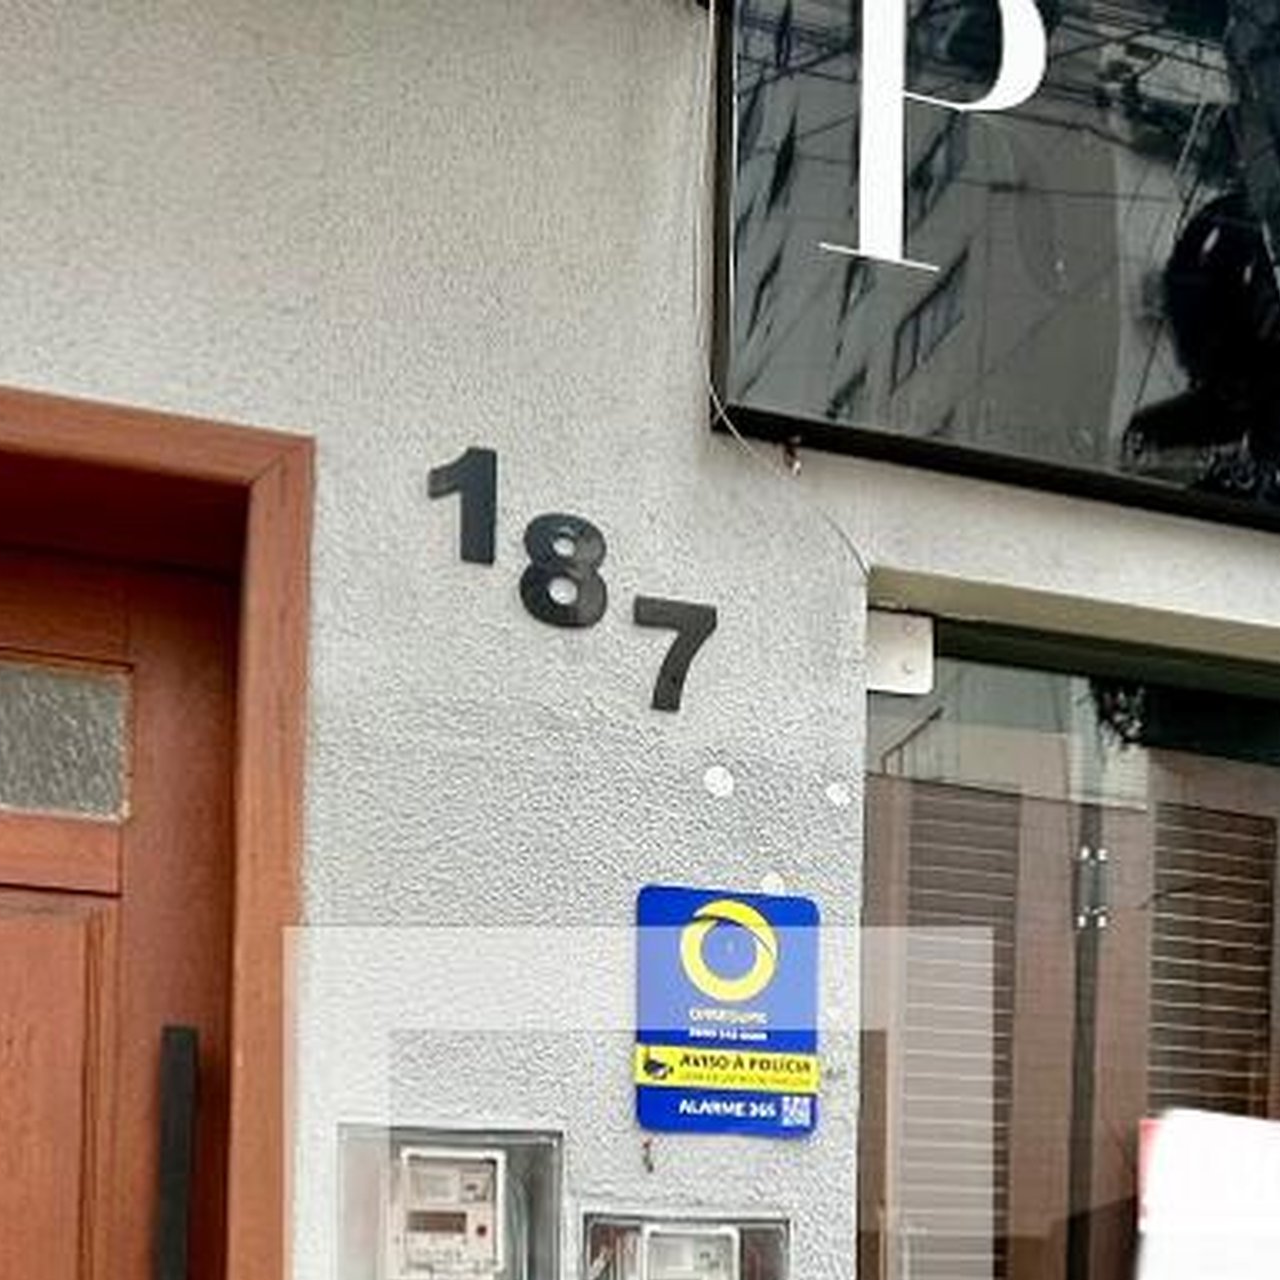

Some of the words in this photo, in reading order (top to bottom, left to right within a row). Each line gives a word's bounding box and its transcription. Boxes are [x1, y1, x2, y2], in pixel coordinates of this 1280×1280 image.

[426, 446, 718, 712] 187
[679, 1053, 729, 1070] AVISO
[679, 1099, 746, 1117] ALARME
